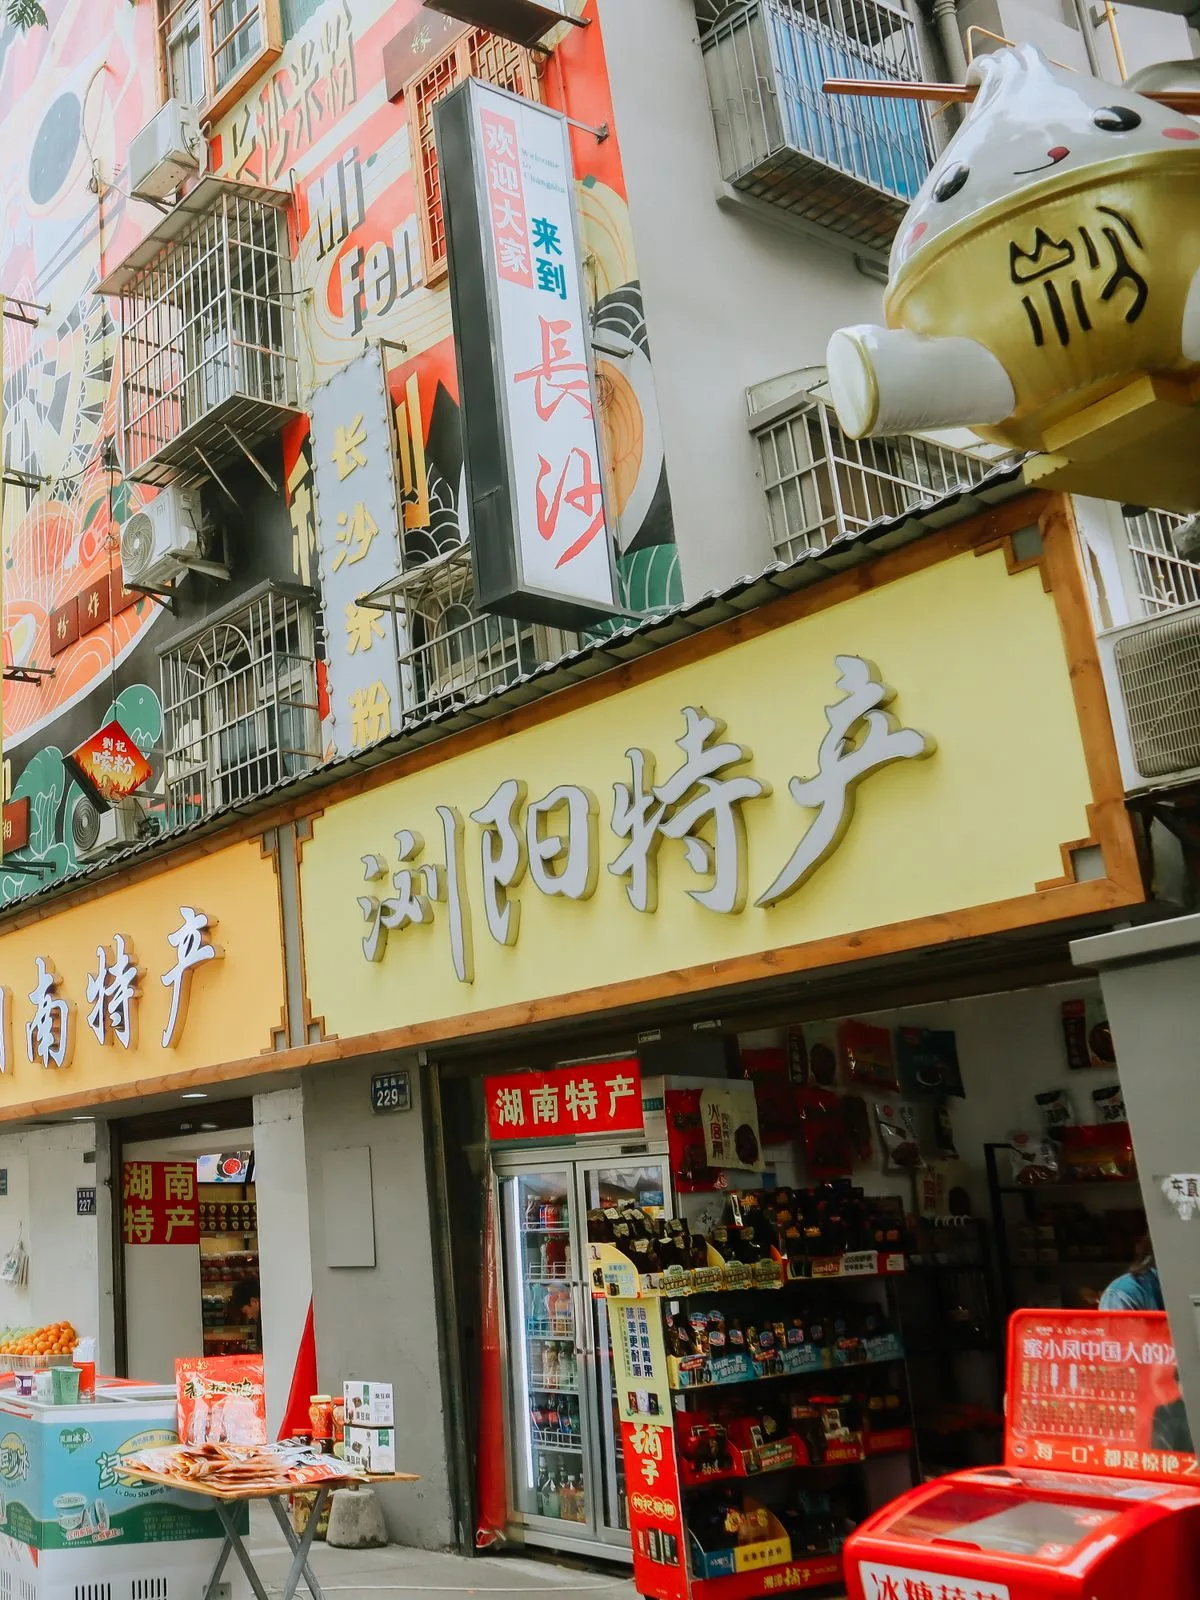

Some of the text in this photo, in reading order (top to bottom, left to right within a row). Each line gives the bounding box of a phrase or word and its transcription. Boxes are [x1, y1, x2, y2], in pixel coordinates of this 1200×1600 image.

[306, 147, 364, 262] Mi
[485, 123, 530, 276] 欢迎大家
[340, 214, 422, 336] Fen
[531, 217, 567, 300] 来到
[331, 414, 391, 749] 长沙米粉
[92, 750, 136, 775] 嗦粉
[356, 653, 936, 983] 浏阳特产
[377, 1088, 398, 1106] 229
[496, 1074, 635, 1127] 湖南特产
[79, 1200, 91, 1211] 227
[123, 1163, 195, 1200] 湖南
[123, 1205, 196, 1243] 特产
[124, 1490, 137, 1498] Dou
[138, 1490, 149, 1498] Sha
